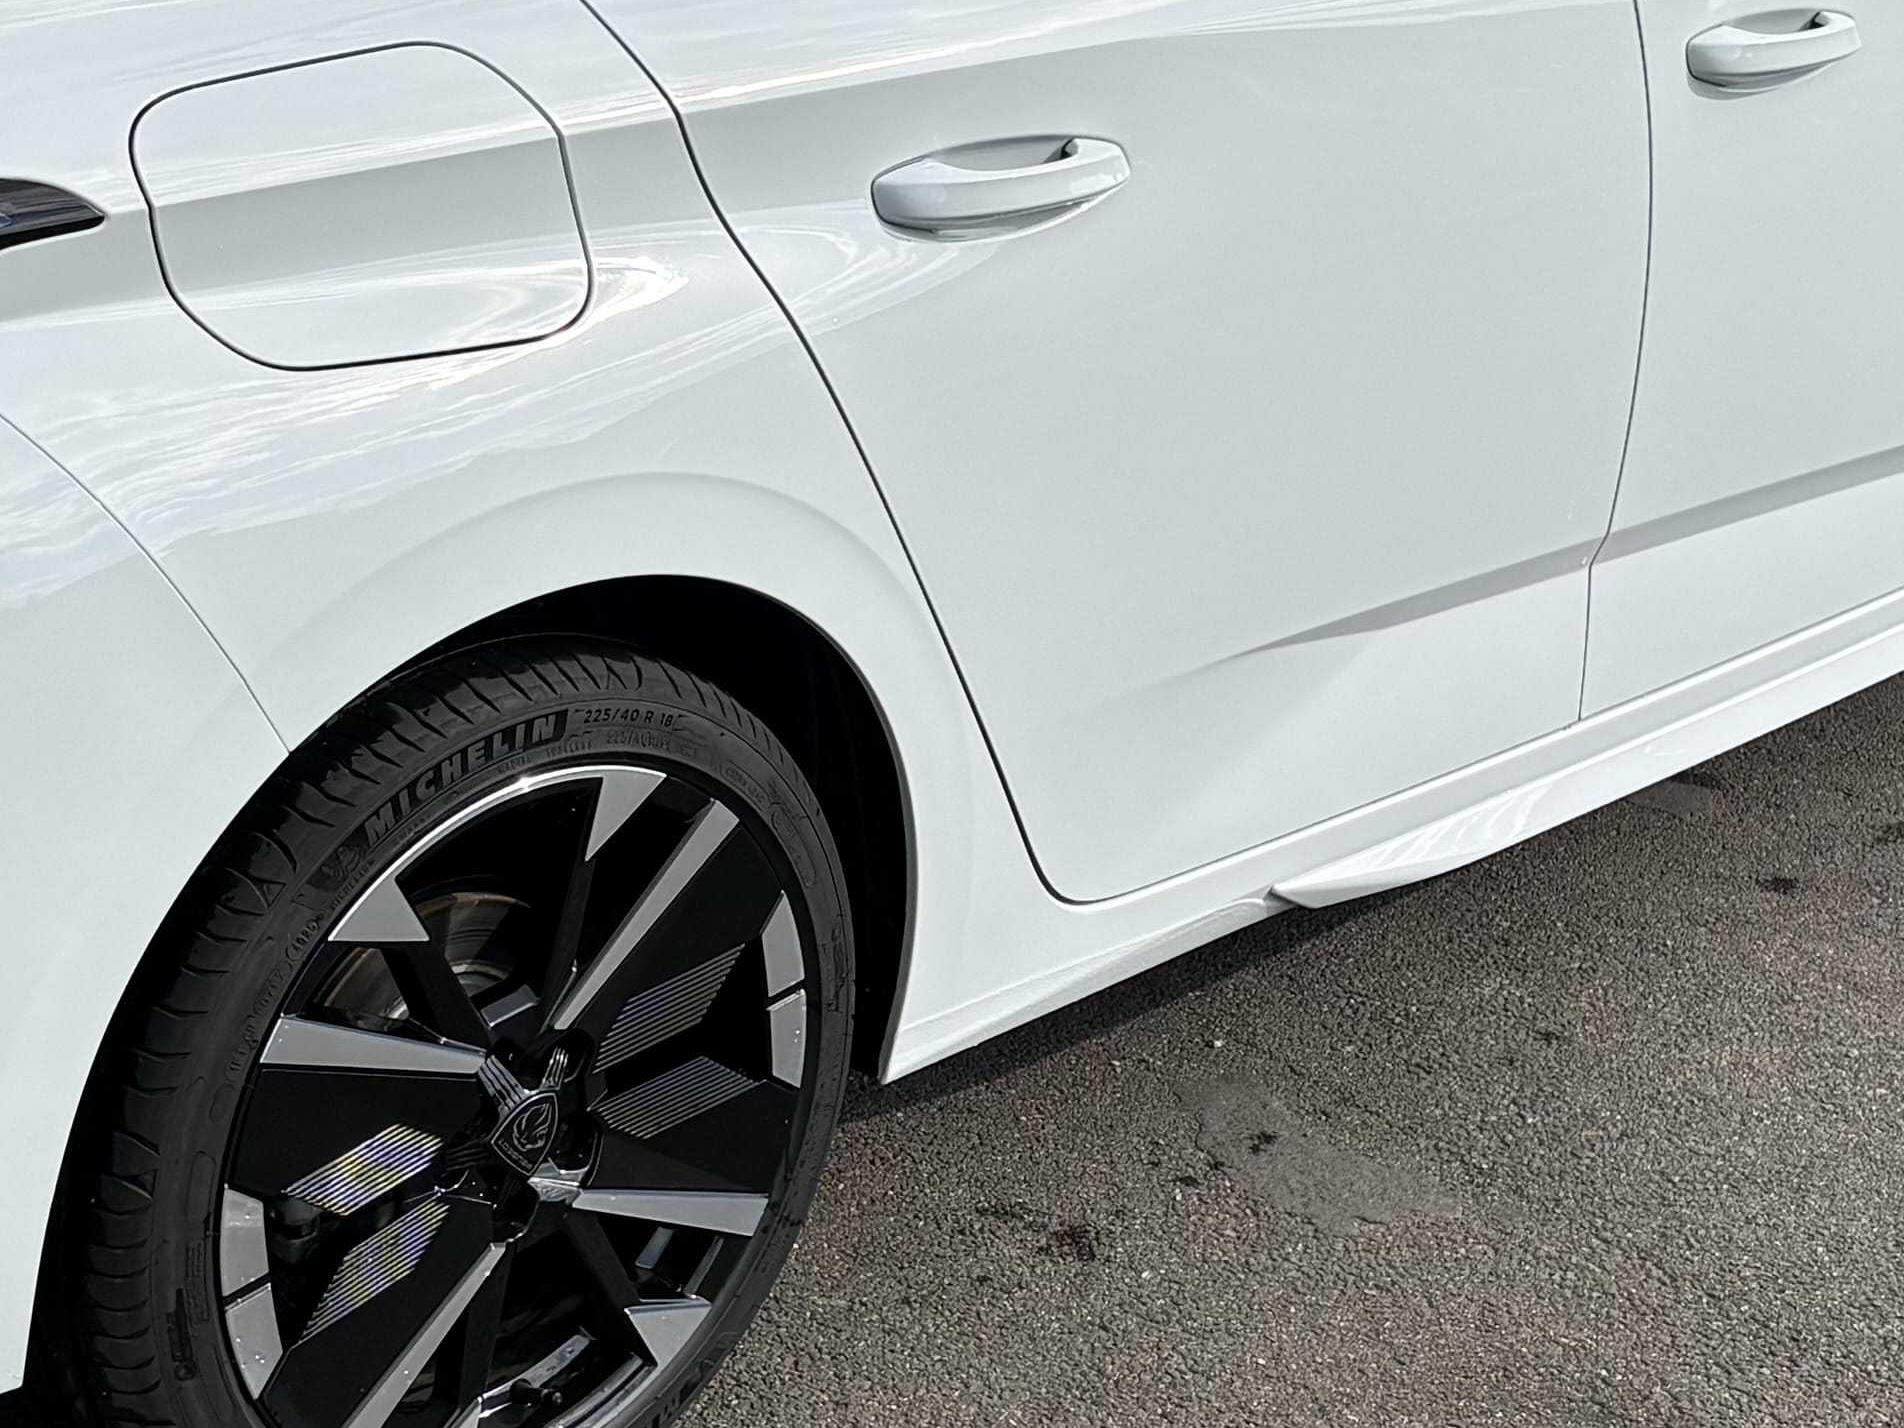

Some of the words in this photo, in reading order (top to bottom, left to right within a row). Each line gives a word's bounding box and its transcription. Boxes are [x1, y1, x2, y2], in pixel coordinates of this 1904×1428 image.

[583, 707, 640, 724] 225/40
[644, 710, 655, 724] R
[660, 712, 675, 728] 18
[363, 715, 556, 847] MICHELIN
